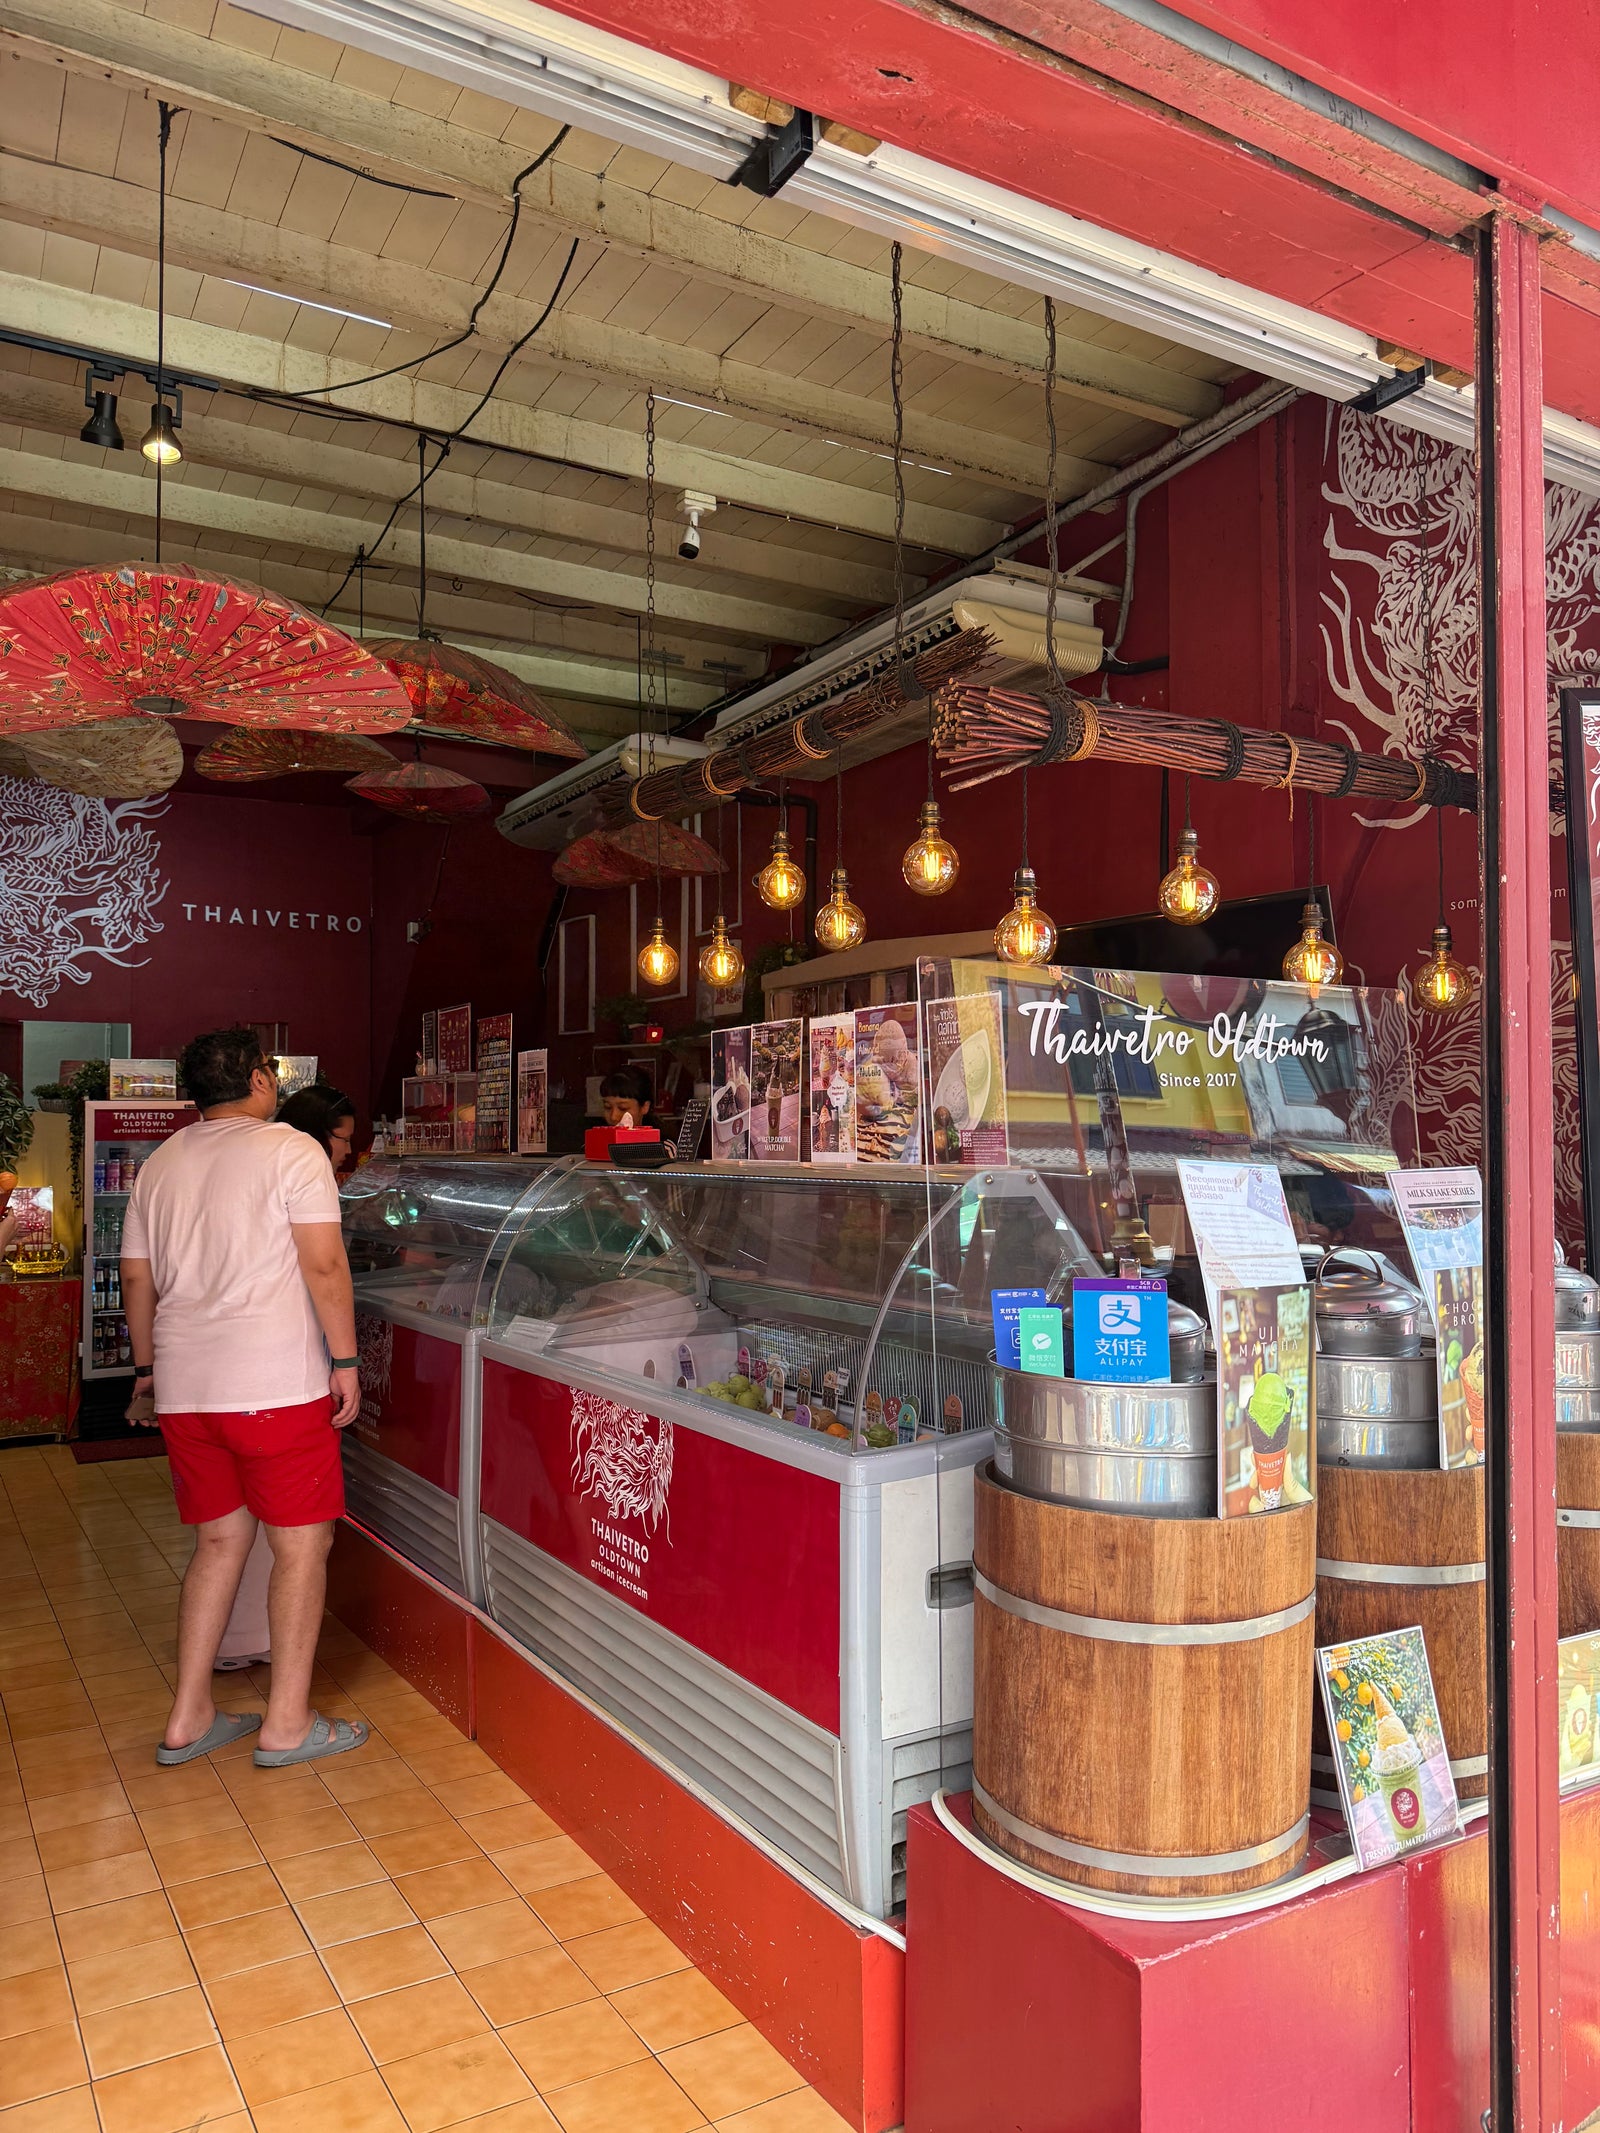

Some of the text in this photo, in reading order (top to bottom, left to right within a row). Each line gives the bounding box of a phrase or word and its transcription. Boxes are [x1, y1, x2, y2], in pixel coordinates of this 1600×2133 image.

[181, 903, 362, 933] THAIVETRO
[858, 1021, 880, 1033] Banana
[1017, 998, 1329, 1064] Thaivetro Oldtown
[1159, 1072, 1237, 1087] Since 2017
[113, 1112, 175, 1120] THAIVETRO
[1406, 1185, 1476, 1199] MILK SHAKE SERIES
[1258, 1326, 1281, 1340] UJI
[1094, 1338, 1147, 1357] 支付宝
[1239, 1338, 1299, 1358] MATCHA
[1100, 1357, 1144, 1367] ALIPAY
[591, 1517, 649, 1563] THAIVETRO
[599, 1544, 641, 1578] OLDTOWN
[590, 1559, 648, 1600] artisan icecream
[1365, 1845, 1387, 1862] FRESH
